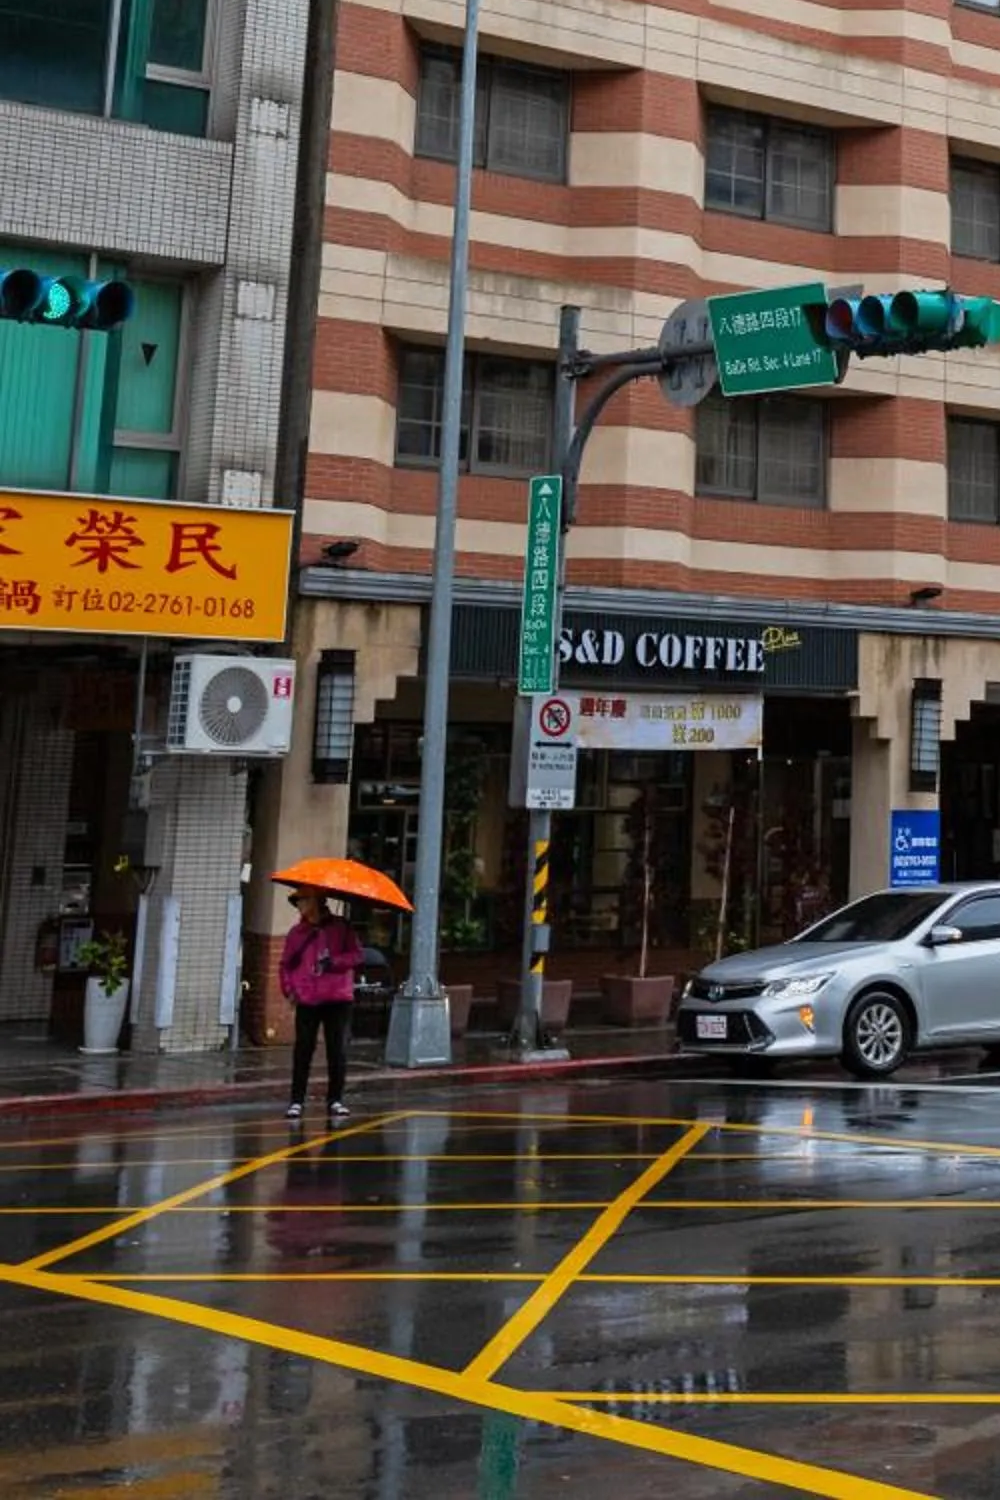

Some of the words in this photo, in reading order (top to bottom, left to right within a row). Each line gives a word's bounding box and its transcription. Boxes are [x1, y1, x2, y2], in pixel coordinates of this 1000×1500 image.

[530, 497, 551, 617] 八德路四段
[558, 627, 625, 665] S&D
[635, 632, 766, 673] COFFEE
